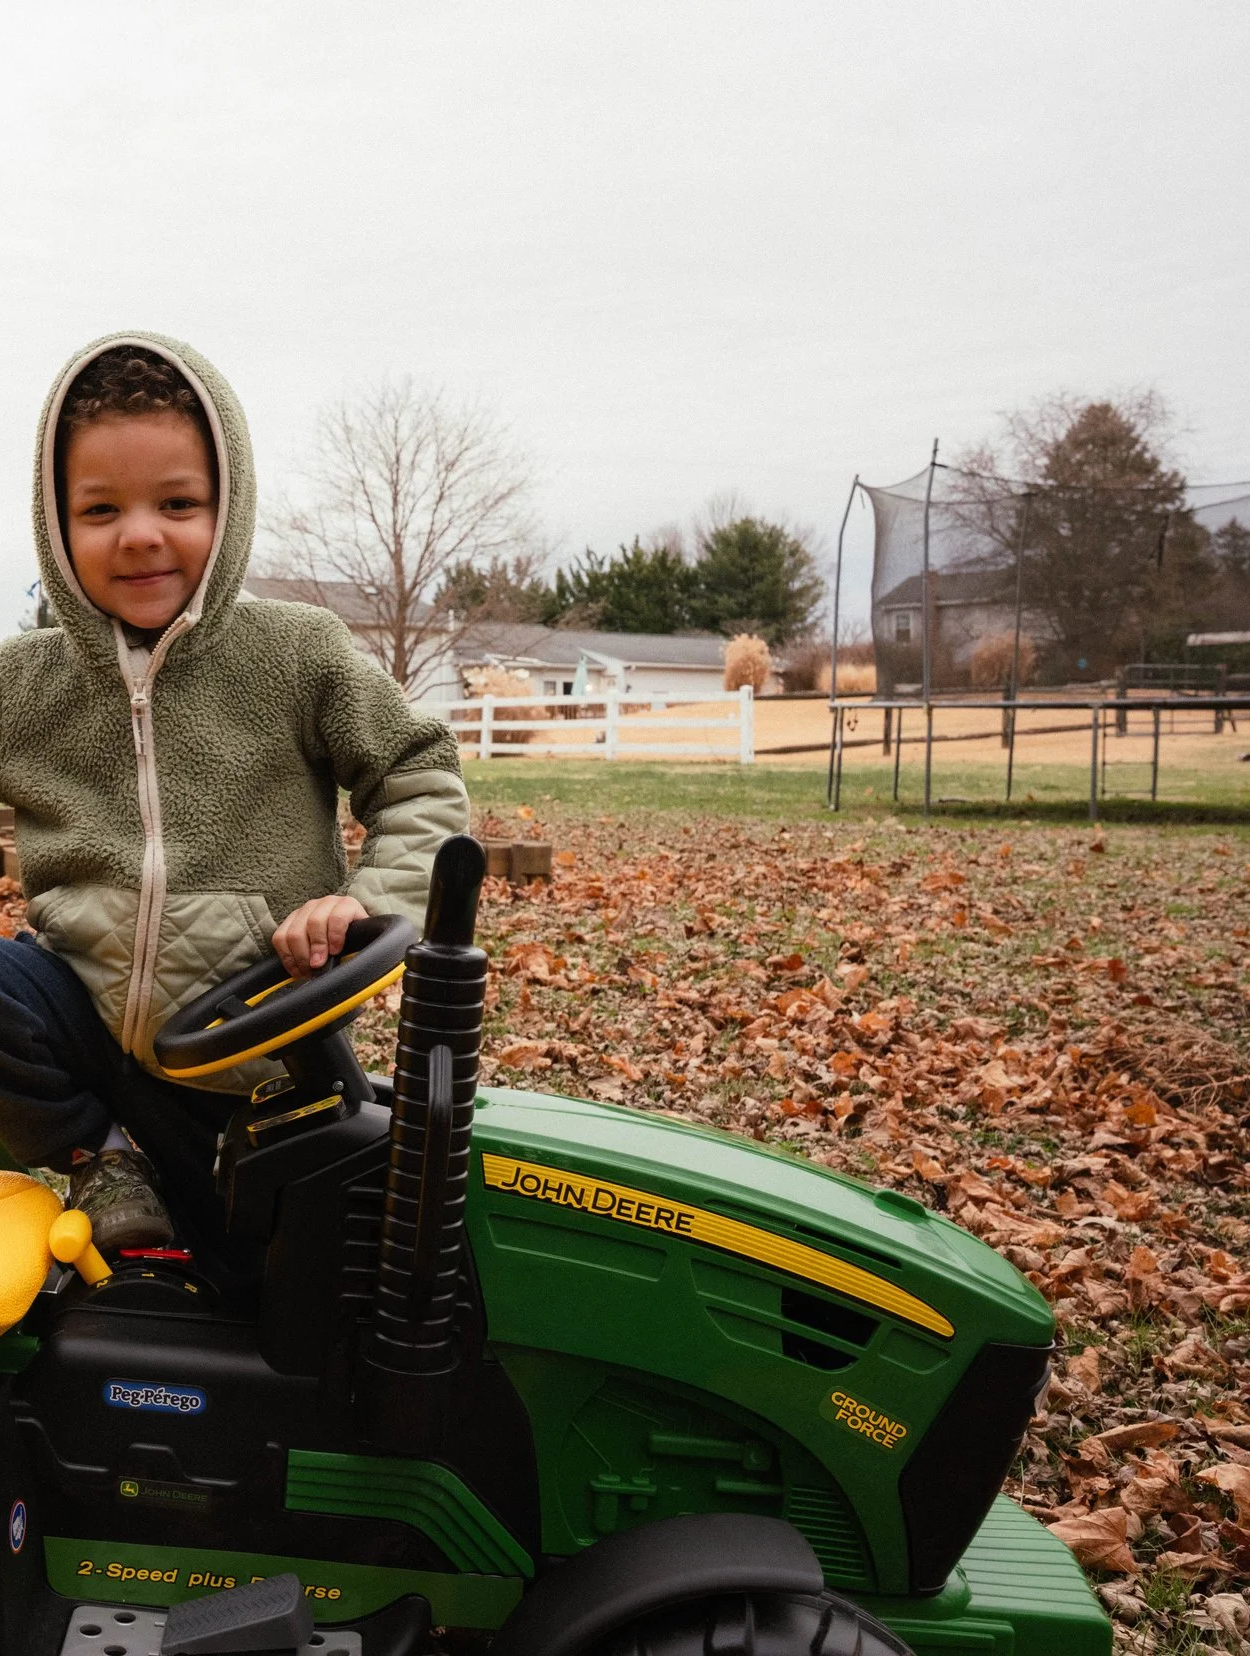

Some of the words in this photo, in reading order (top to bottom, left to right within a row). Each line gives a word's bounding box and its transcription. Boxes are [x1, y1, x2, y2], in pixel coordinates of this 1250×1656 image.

[501, 1166, 586, 1207] JOHN
[591, 1188, 695, 1234] DEERE
[831, 1391, 907, 1438] GROUND
[835, 1409, 898, 1449] FORCE
[141, 1487, 170, 1498] JOHN
[172, 1490, 207, 1502] DEERE
[77, 1559, 179, 1583] 2-Speed
[187, 1571, 237, 1590] plus
